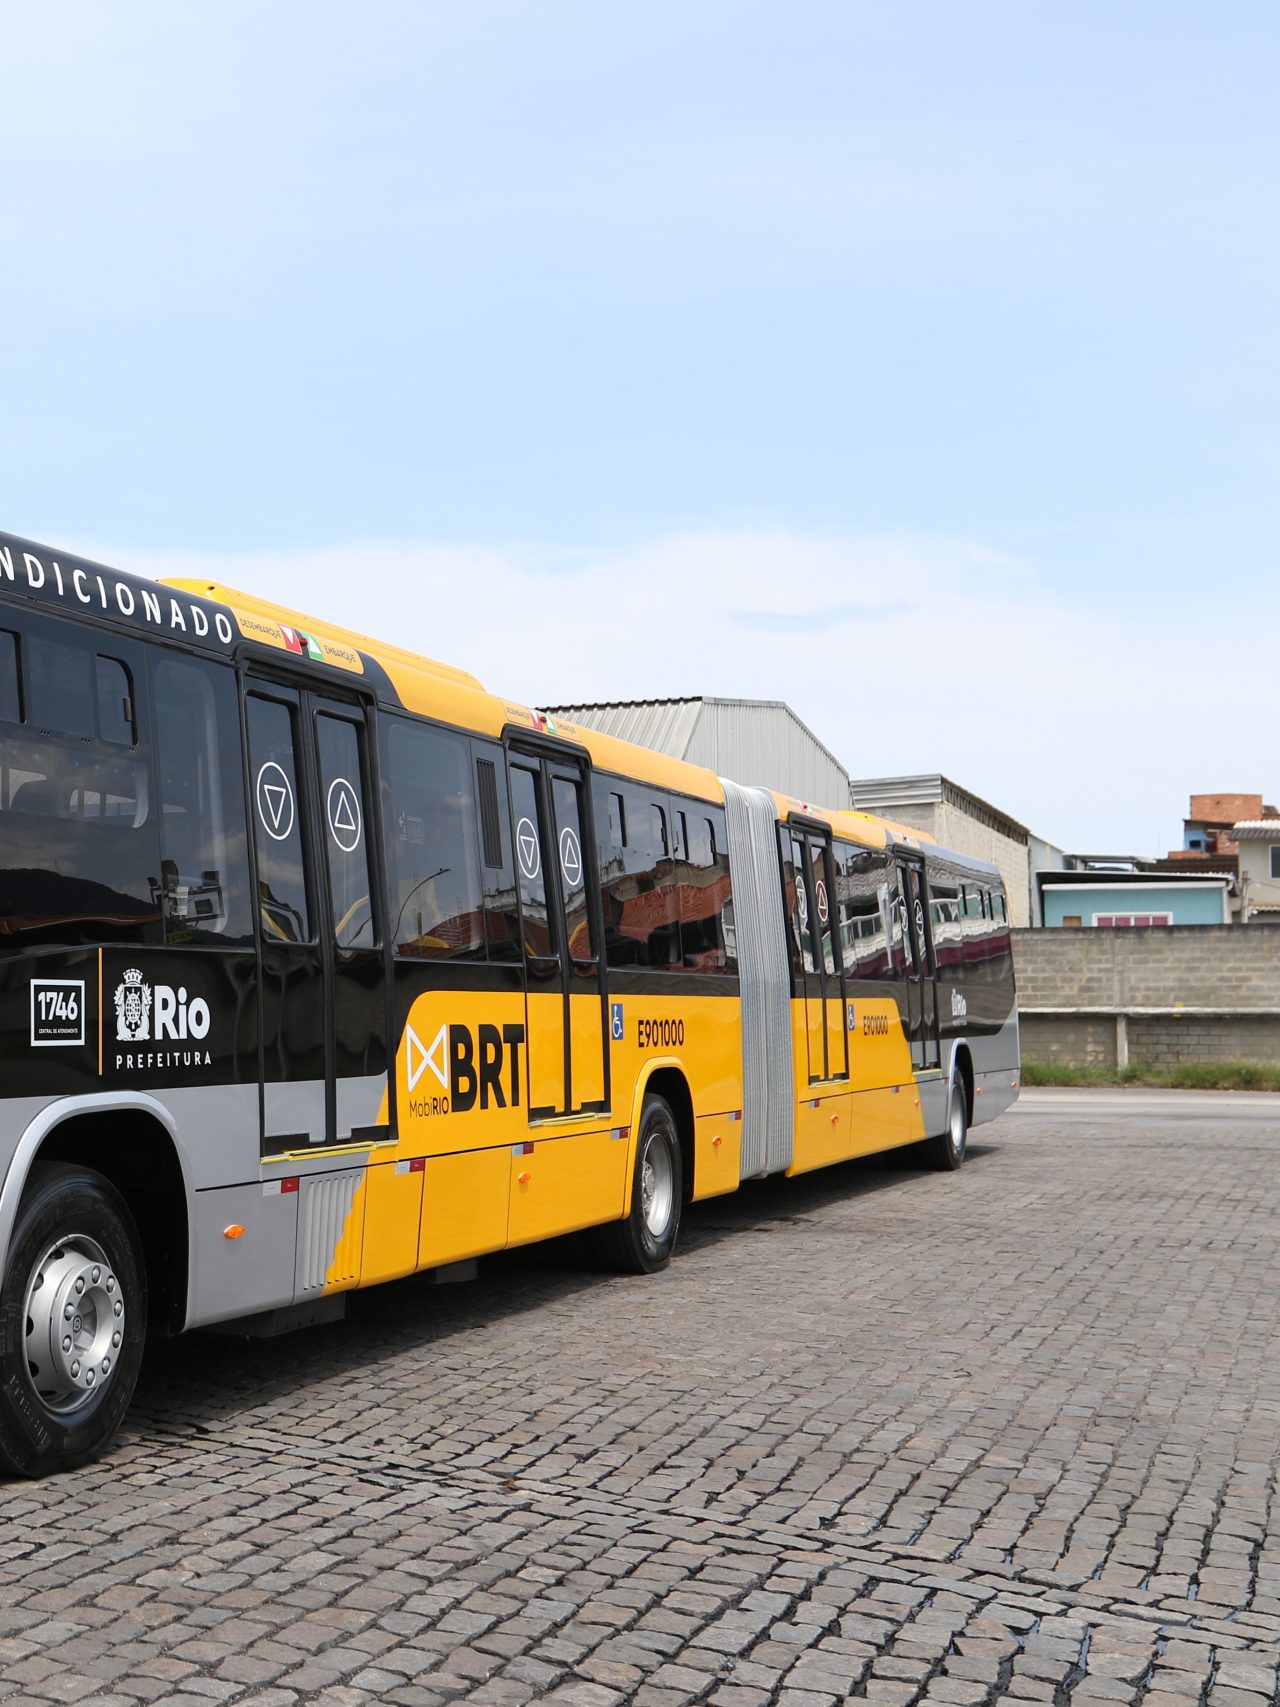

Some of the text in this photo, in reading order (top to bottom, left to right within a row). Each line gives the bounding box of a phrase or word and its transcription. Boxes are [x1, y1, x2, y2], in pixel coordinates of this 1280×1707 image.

[239, 618, 282, 639] DESEMBARQUE
[324, 645, 357, 663] EMBARQUE
[37, 991, 79, 1021] 1746
[154, 985, 211, 1040] Rio
[637, 1019, 685, 1048] E901000
[863, 1016, 889, 1036] E901000
[116, 1051, 212, 1070] PREFEITURA
[449, 1023, 525, 1113] BRT
[409, 1096, 449, 1118] MobiRIO
